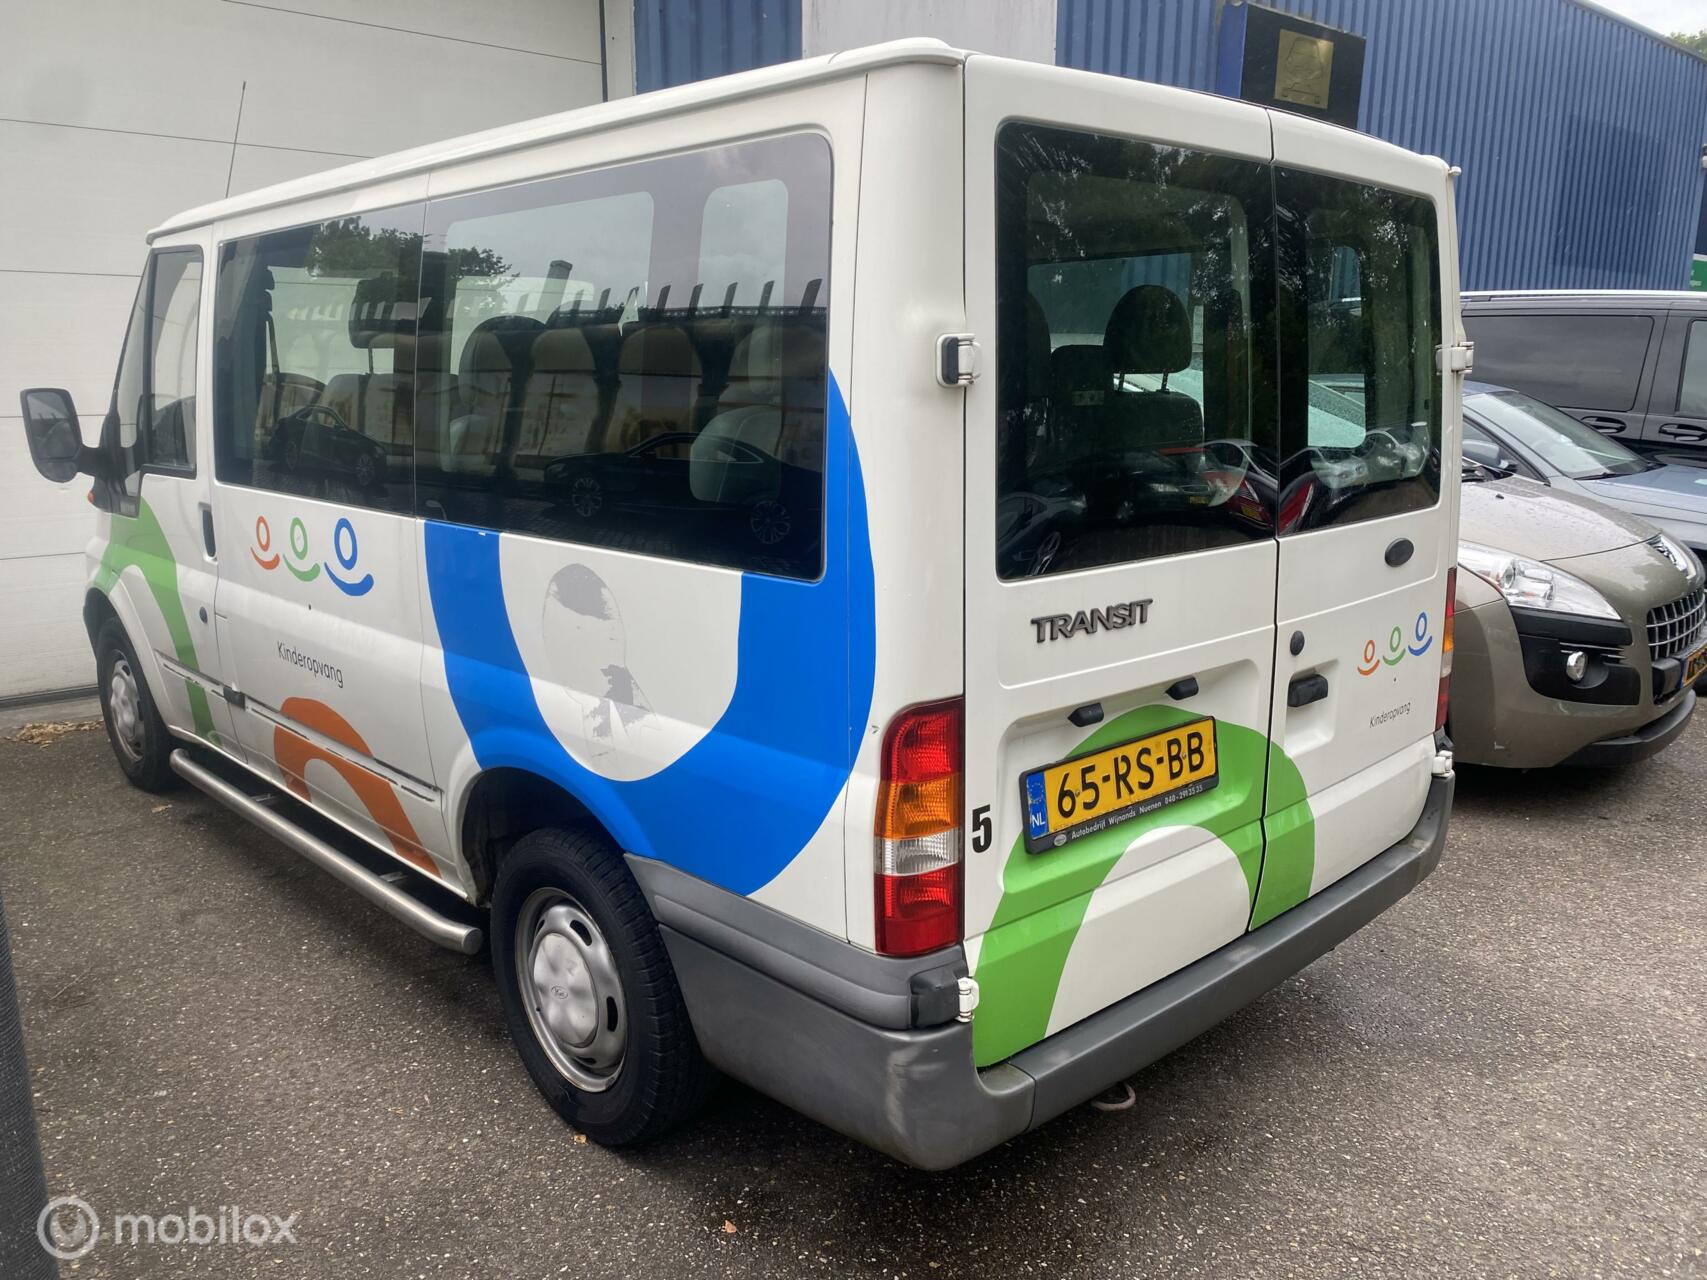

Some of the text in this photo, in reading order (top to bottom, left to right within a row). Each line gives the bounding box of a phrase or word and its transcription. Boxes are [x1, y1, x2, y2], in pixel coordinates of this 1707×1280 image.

[1030, 598, 1153, 643] TRANSIT
[277, 641, 344, 688] Kinderopvang
[1369, 702, 1411, 728] Kinderopvang
[1057, 731, 1205, 819] 65-RS-BB
[972, 804, 992, 853] 5
[1031, 812, 1046, 828] NL
[1139, 801, 1162, 814] Nuenen
